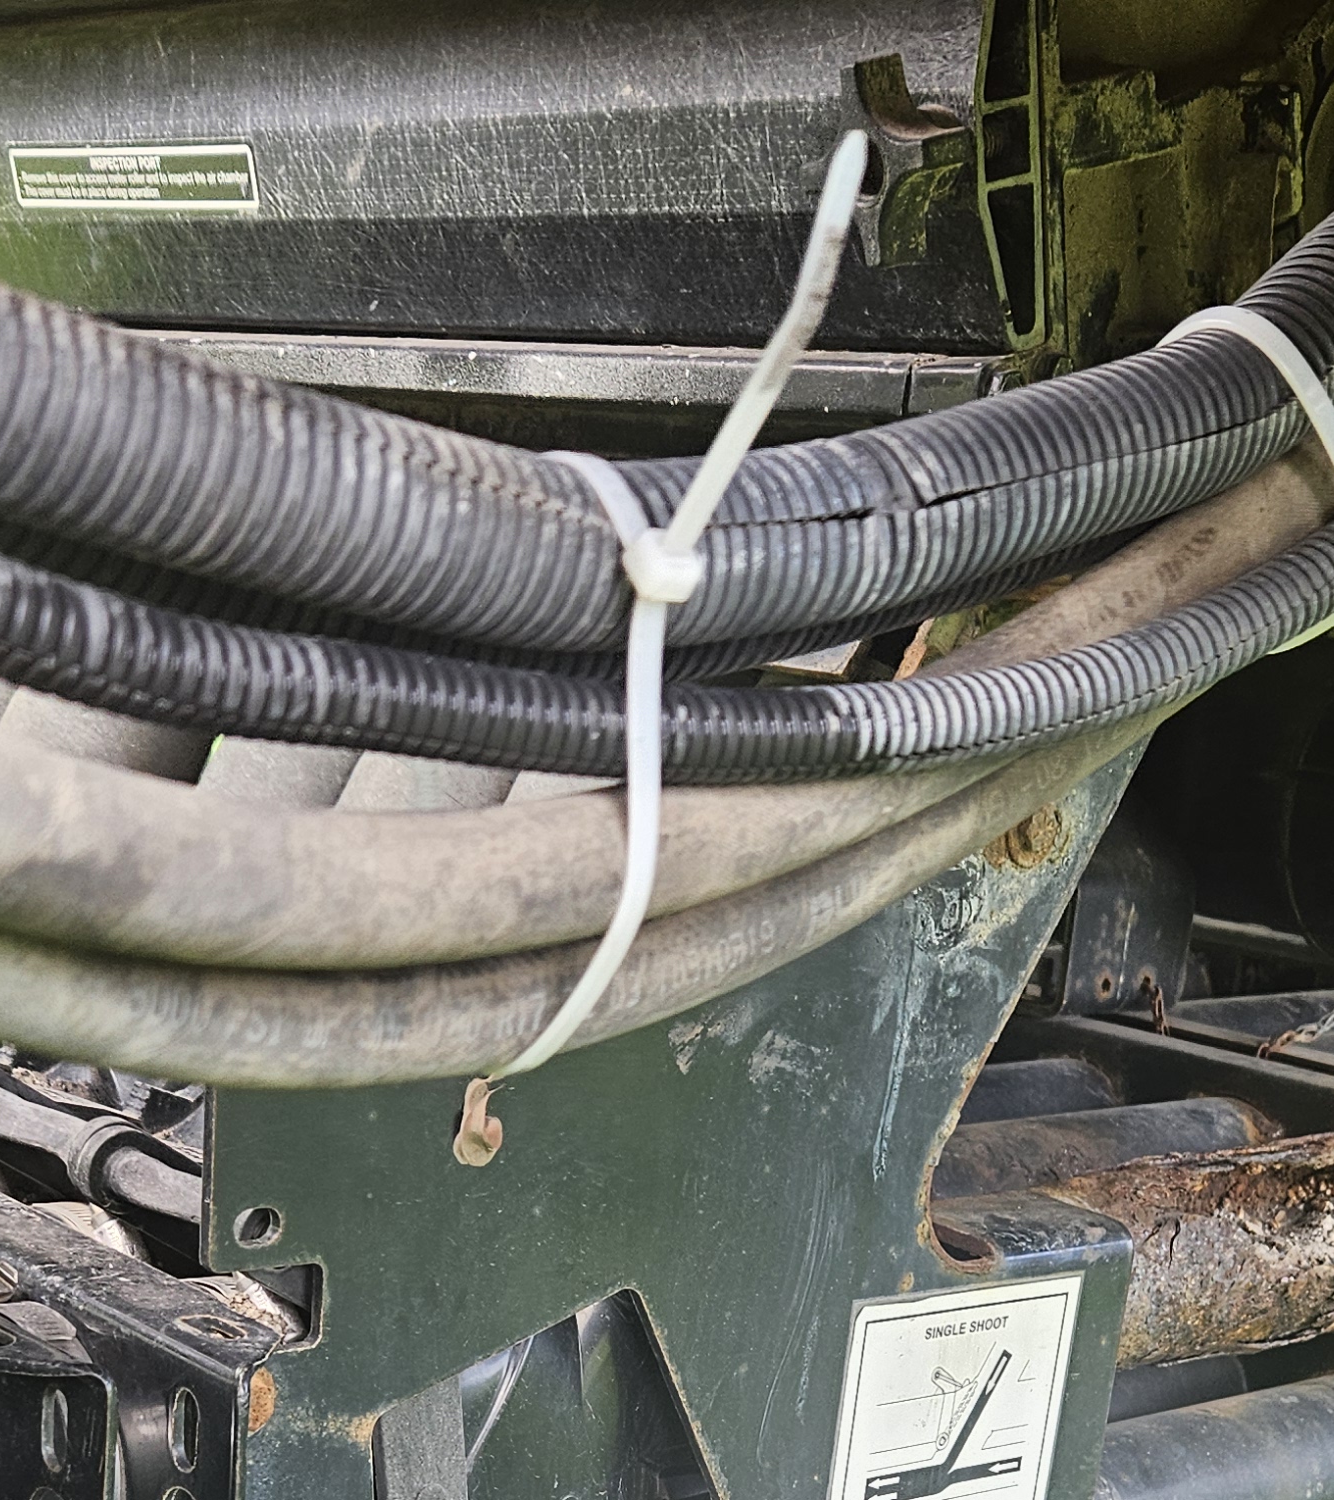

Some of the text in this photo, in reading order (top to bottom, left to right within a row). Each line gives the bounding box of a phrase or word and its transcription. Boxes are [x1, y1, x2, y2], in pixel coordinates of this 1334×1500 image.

[89, 156, 161, 171] INSPECTION PORT
[924, 1315, 1009, 1340] SINGLE SHOOT
